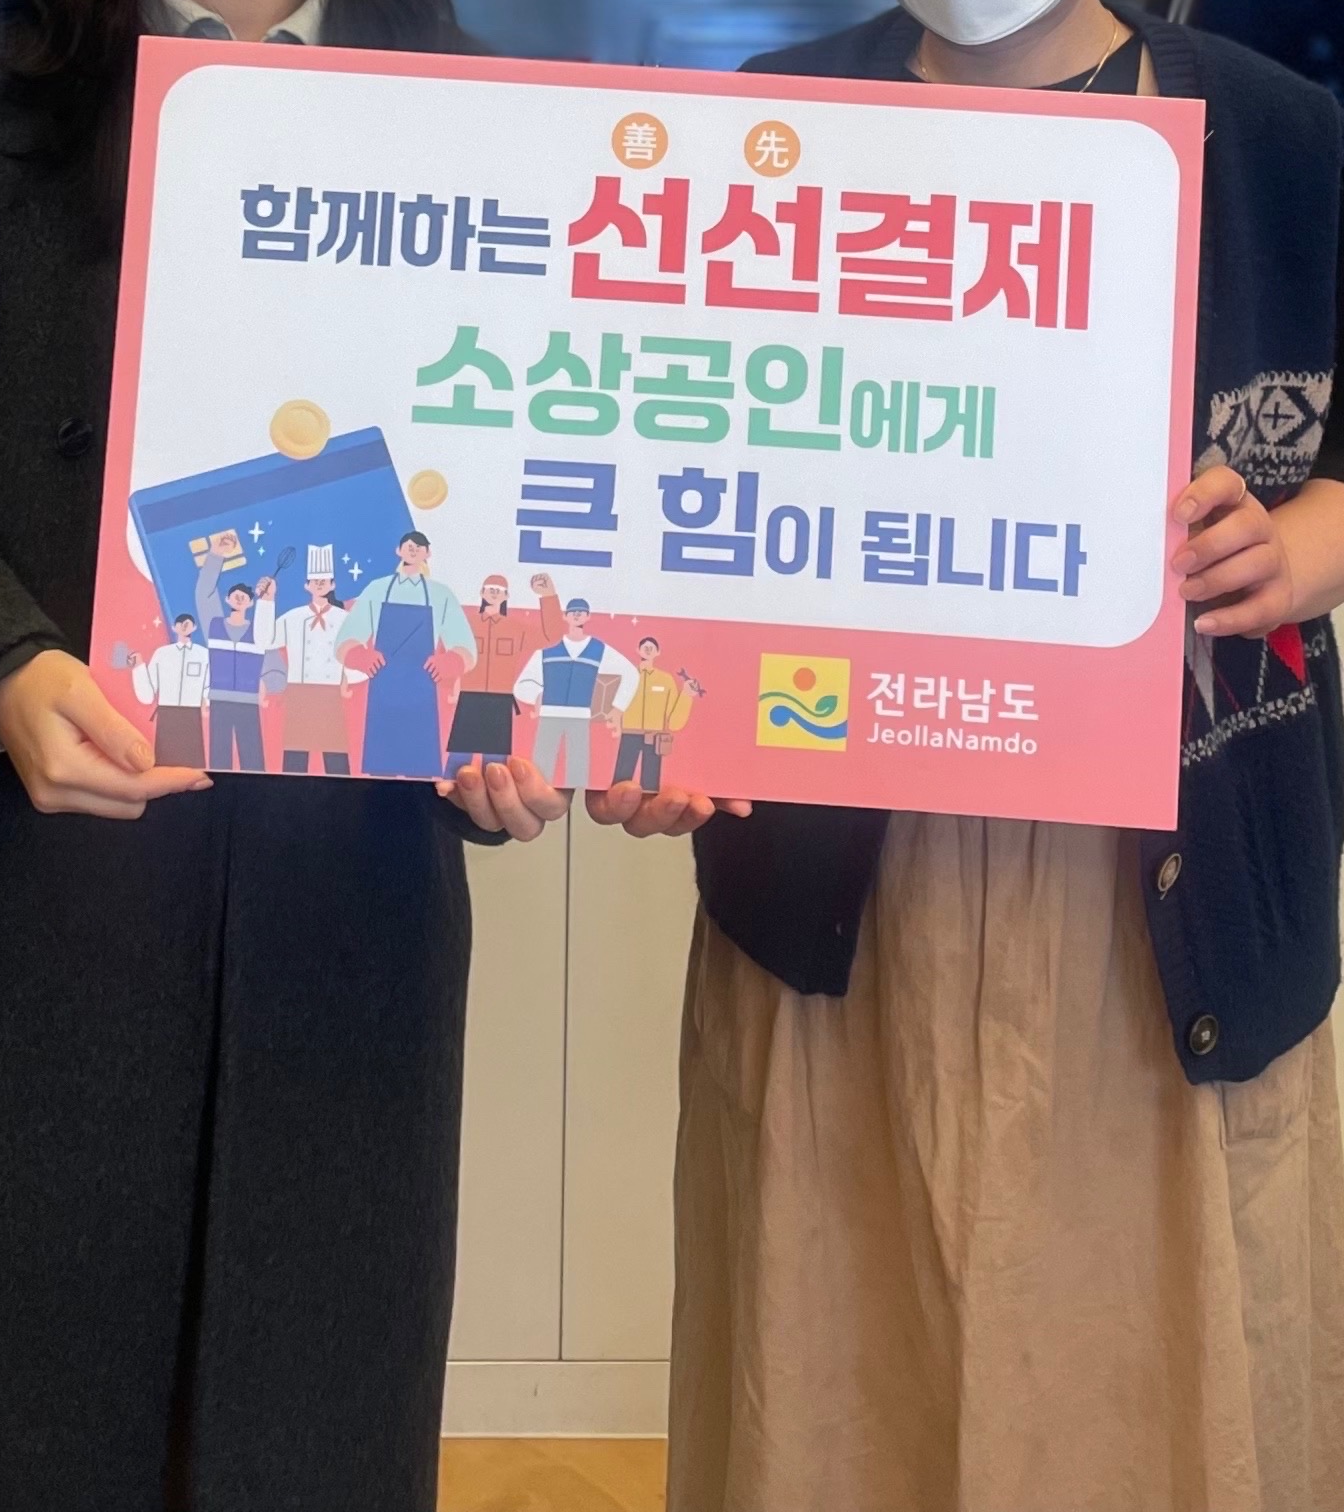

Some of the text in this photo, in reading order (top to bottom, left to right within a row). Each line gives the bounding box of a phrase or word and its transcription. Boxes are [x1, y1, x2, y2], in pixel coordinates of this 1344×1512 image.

[622, 122, 790, 169] 善 先
[241, 175, 1093, 330] 함께하는 선선결제
[412, 326, 996, 458] 소상공인에게
[516, 459, 1088, 597] 큰 힘이 됩니다
[867, 672, 1039, 724] 전라남도
[867, 722, 1039, 755] JeollaNamdo
